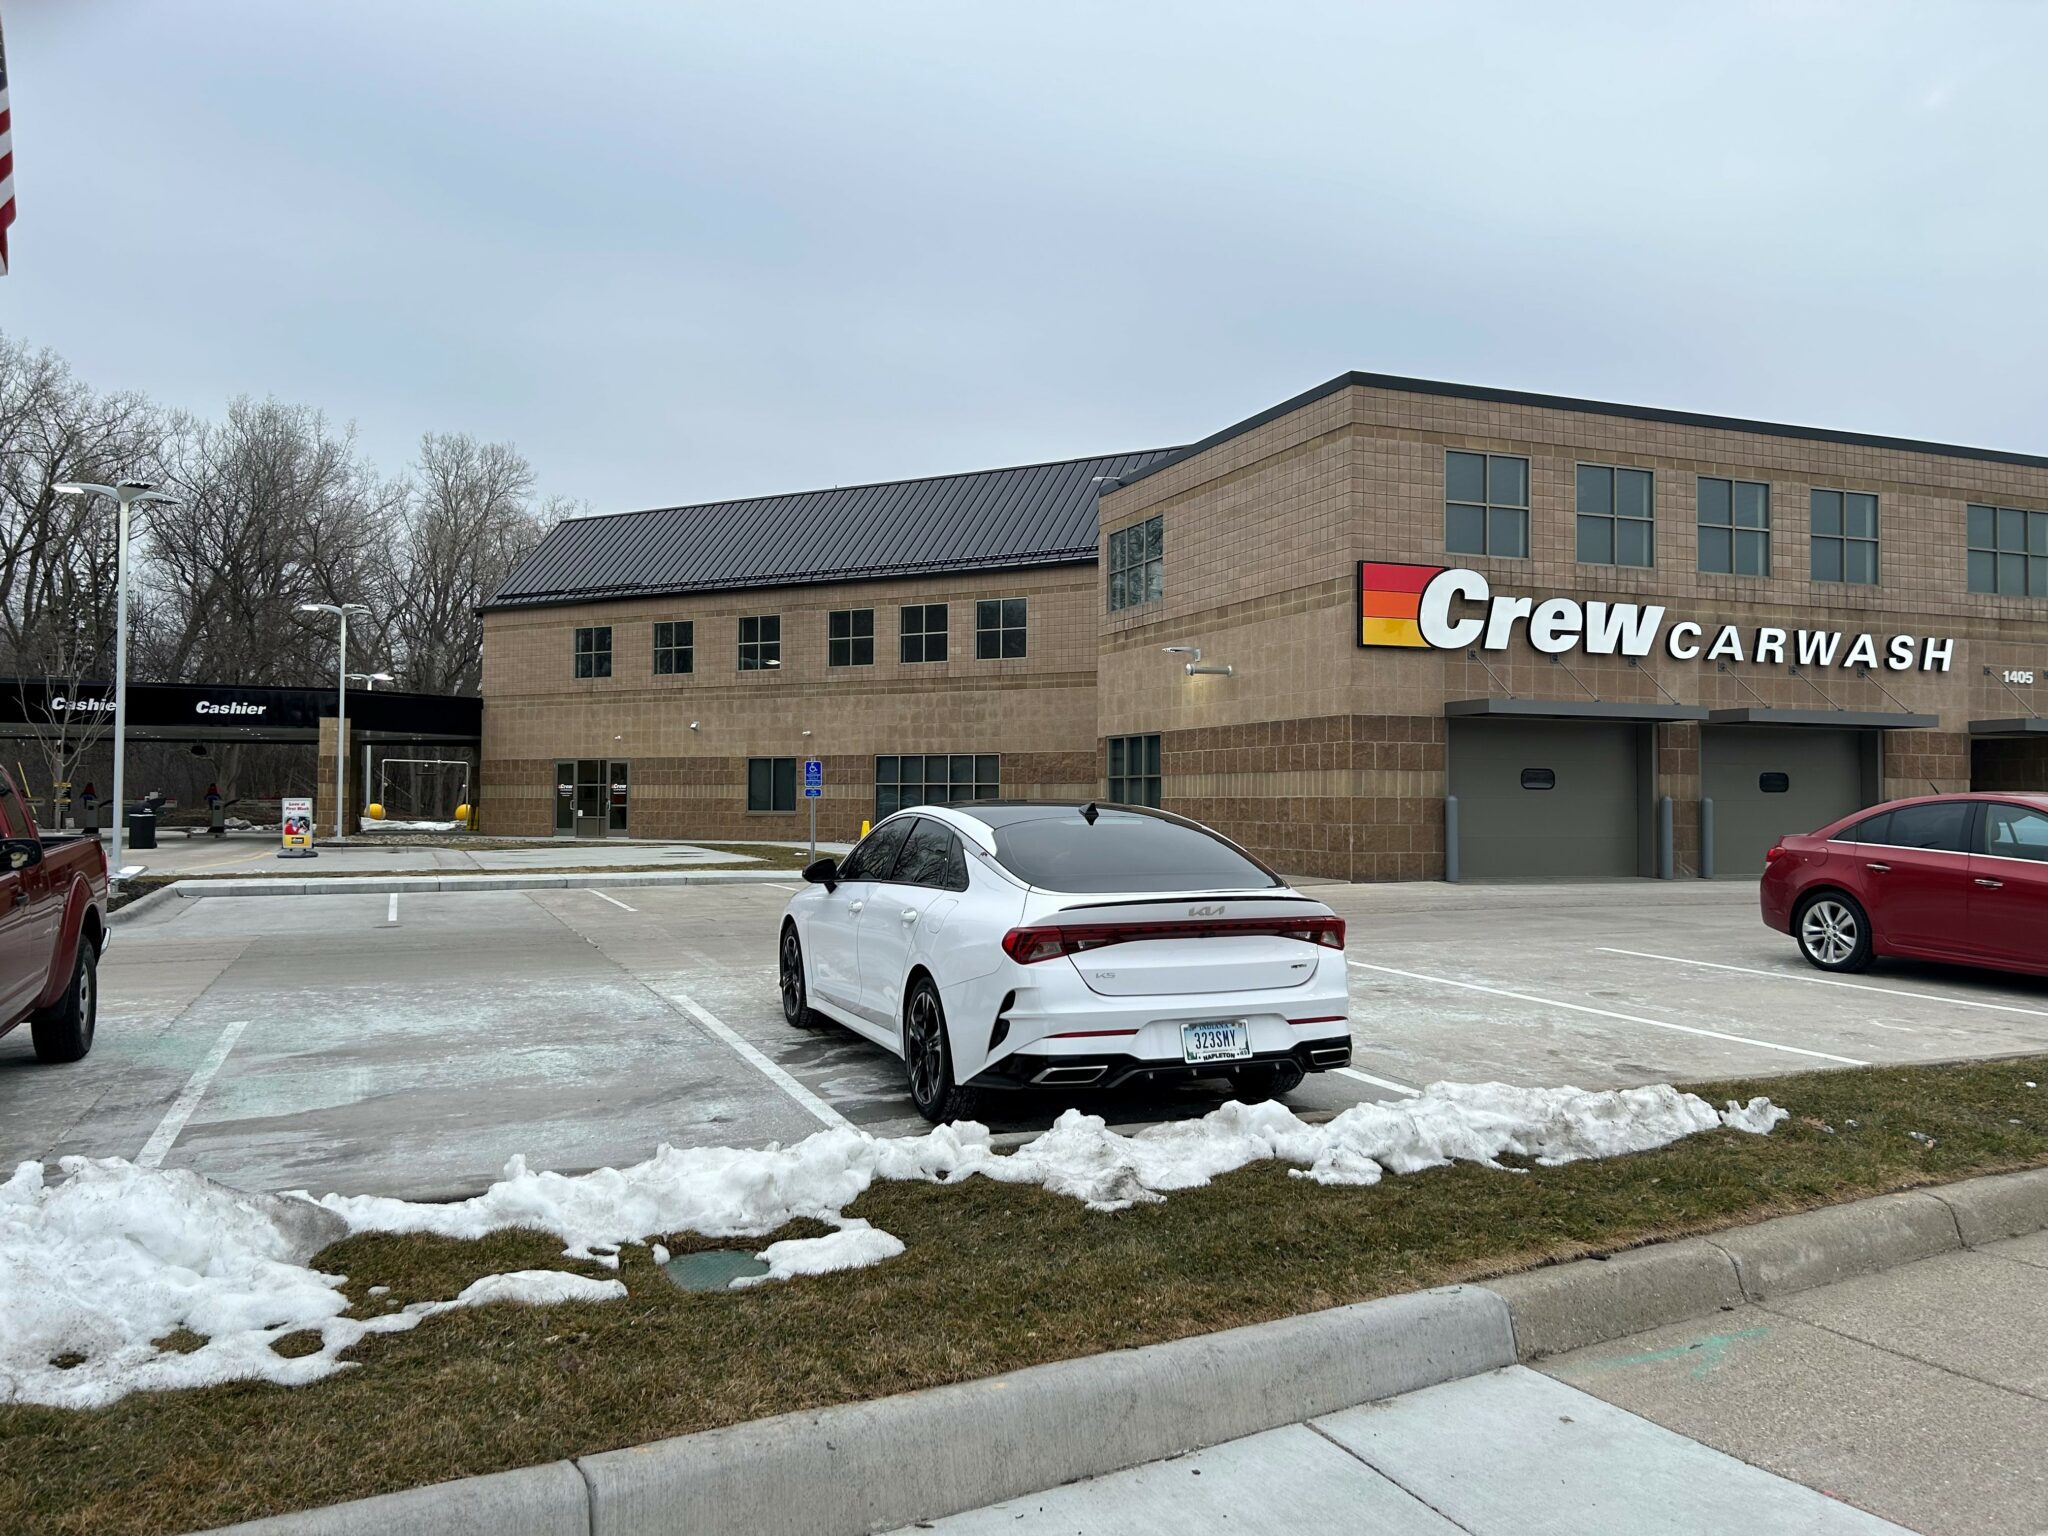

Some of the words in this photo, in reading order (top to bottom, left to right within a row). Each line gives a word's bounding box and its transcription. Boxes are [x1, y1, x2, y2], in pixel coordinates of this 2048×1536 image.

[1419, 567, 1667, 656] Crew
[1667, 620, 1955, 673] CARWASH
[2002, 670, 2034, 684] 1405
[51, 696, 117, 711] Cashie
[195, 701, 267, 715] Cashier
[1194, 1029, 1236, 1050] 323SMY
[1202, 1052, 1236, 1062] NAPLETON
